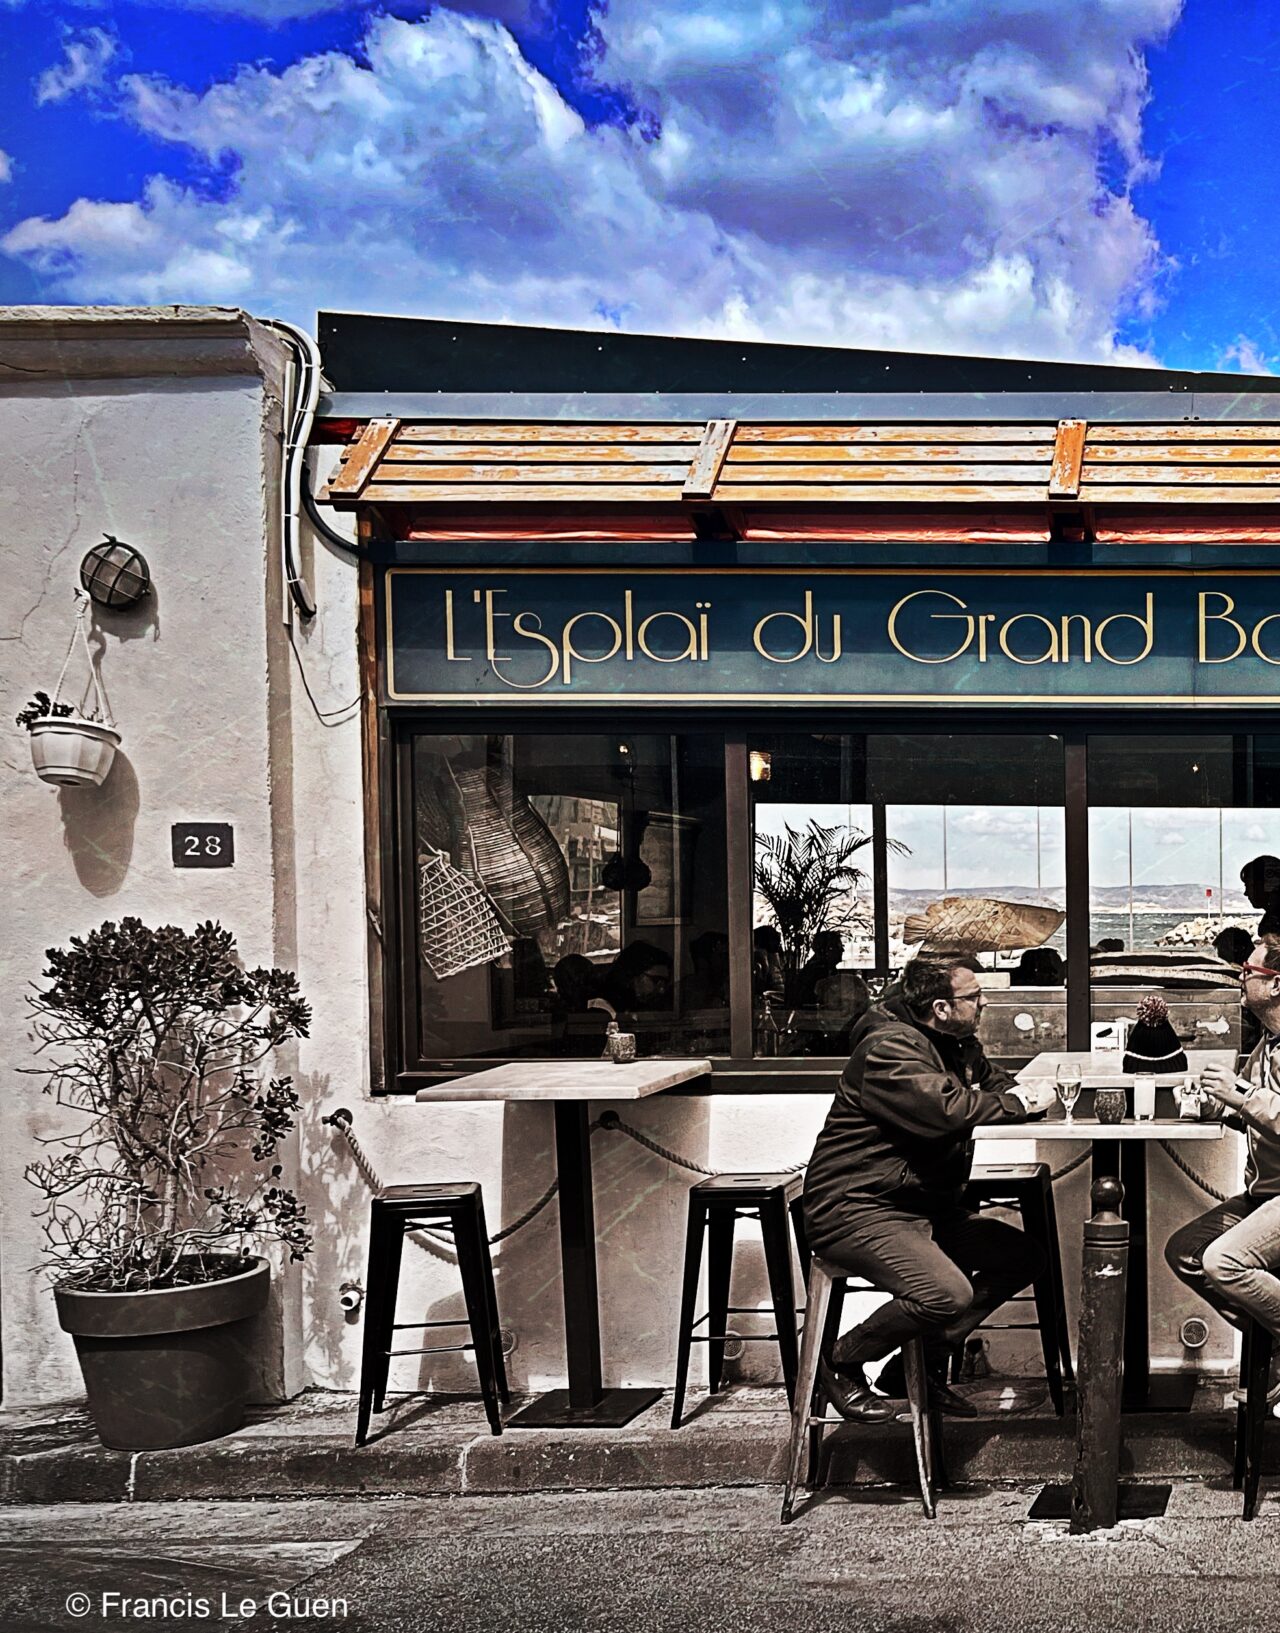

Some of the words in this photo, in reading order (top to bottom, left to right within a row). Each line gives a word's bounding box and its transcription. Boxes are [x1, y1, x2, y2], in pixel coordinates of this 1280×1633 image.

[445, 589, 712, 688] L'Esplaï
[753, 590, 842, 664] du
[887, 589, 1155, 666] Grand
[184, 835, 222, 856] 28
